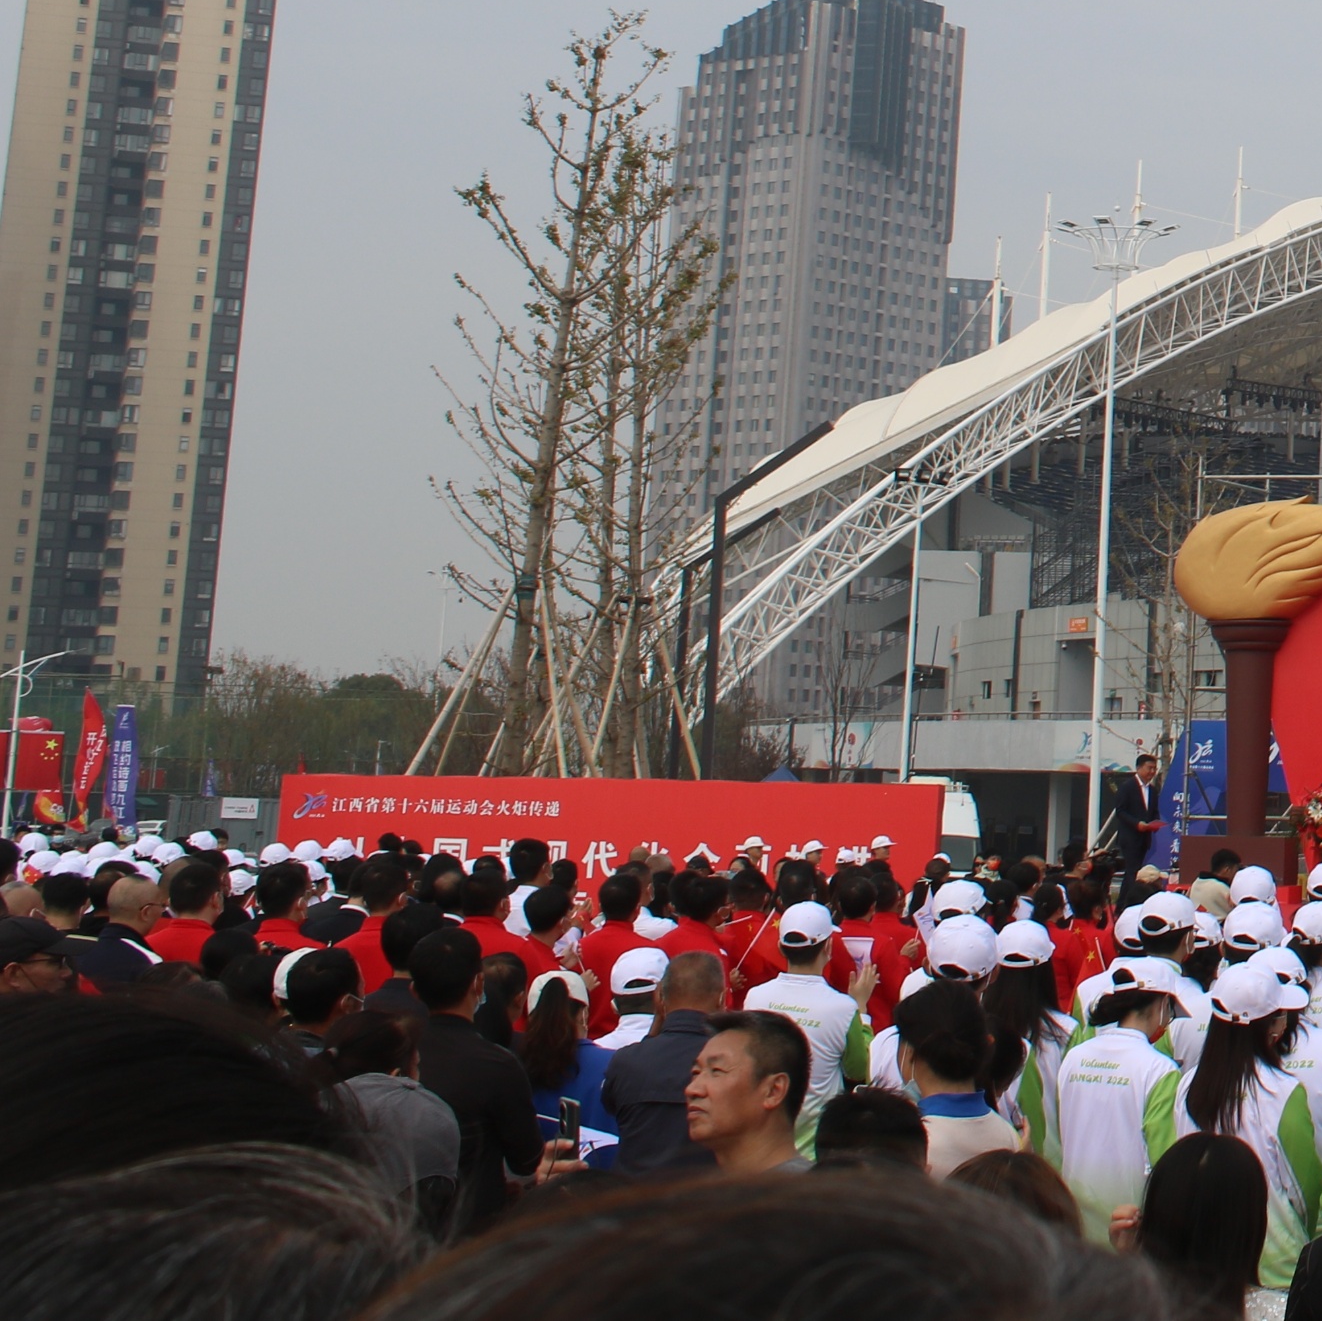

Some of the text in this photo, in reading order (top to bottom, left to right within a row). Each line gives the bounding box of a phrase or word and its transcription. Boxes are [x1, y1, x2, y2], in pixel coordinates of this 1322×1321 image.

[332, 796, 560, 817] 江西省第十六届运动会火炬传递
[768, 1001, 810, 1014] Volunteer
[1080, 1058, 1120, 1070] Volunteer
[1285, 1059, 1315, 1069] 2022
[1107, 1075, 1131, 1086] 2022
